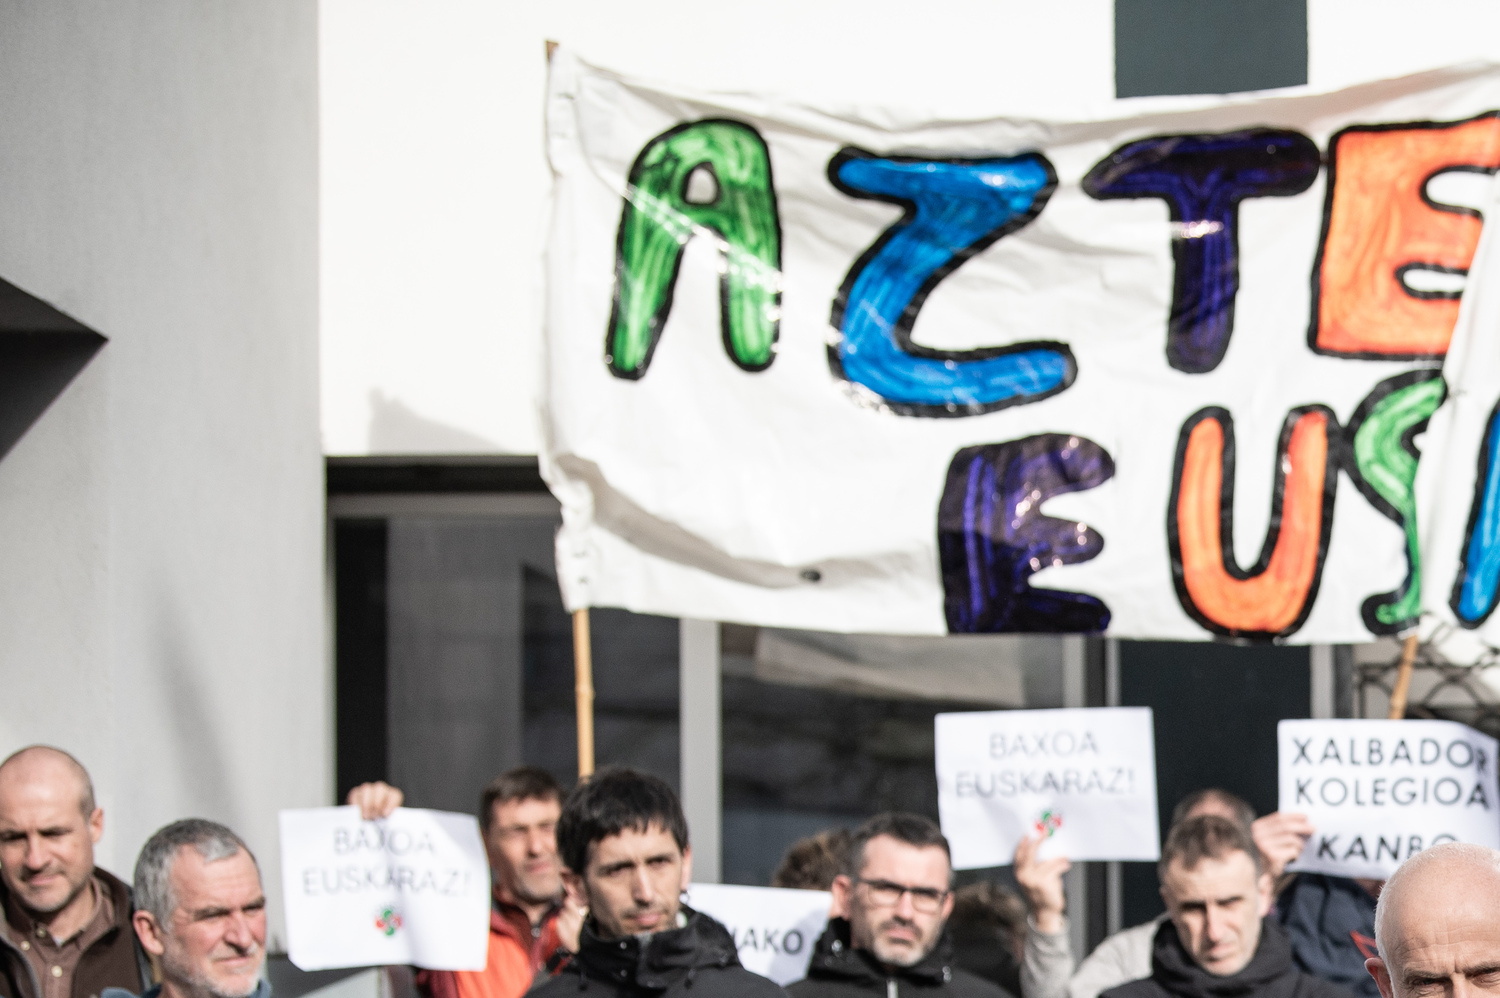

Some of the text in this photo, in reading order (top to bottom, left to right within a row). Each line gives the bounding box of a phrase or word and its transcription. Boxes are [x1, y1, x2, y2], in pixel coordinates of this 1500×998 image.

[990, 731, 1098, 759] BAXOA
[1293, 737, 1488, 773] XALBADOR
[955, 768, 1135, 798] EUSKARAZ!
[1296, 777, 1490, 811] KOLEGIOA
[334, 828, 436, 857] BAXOA
[302, 866, 471, 897] EUSKARAZ!
